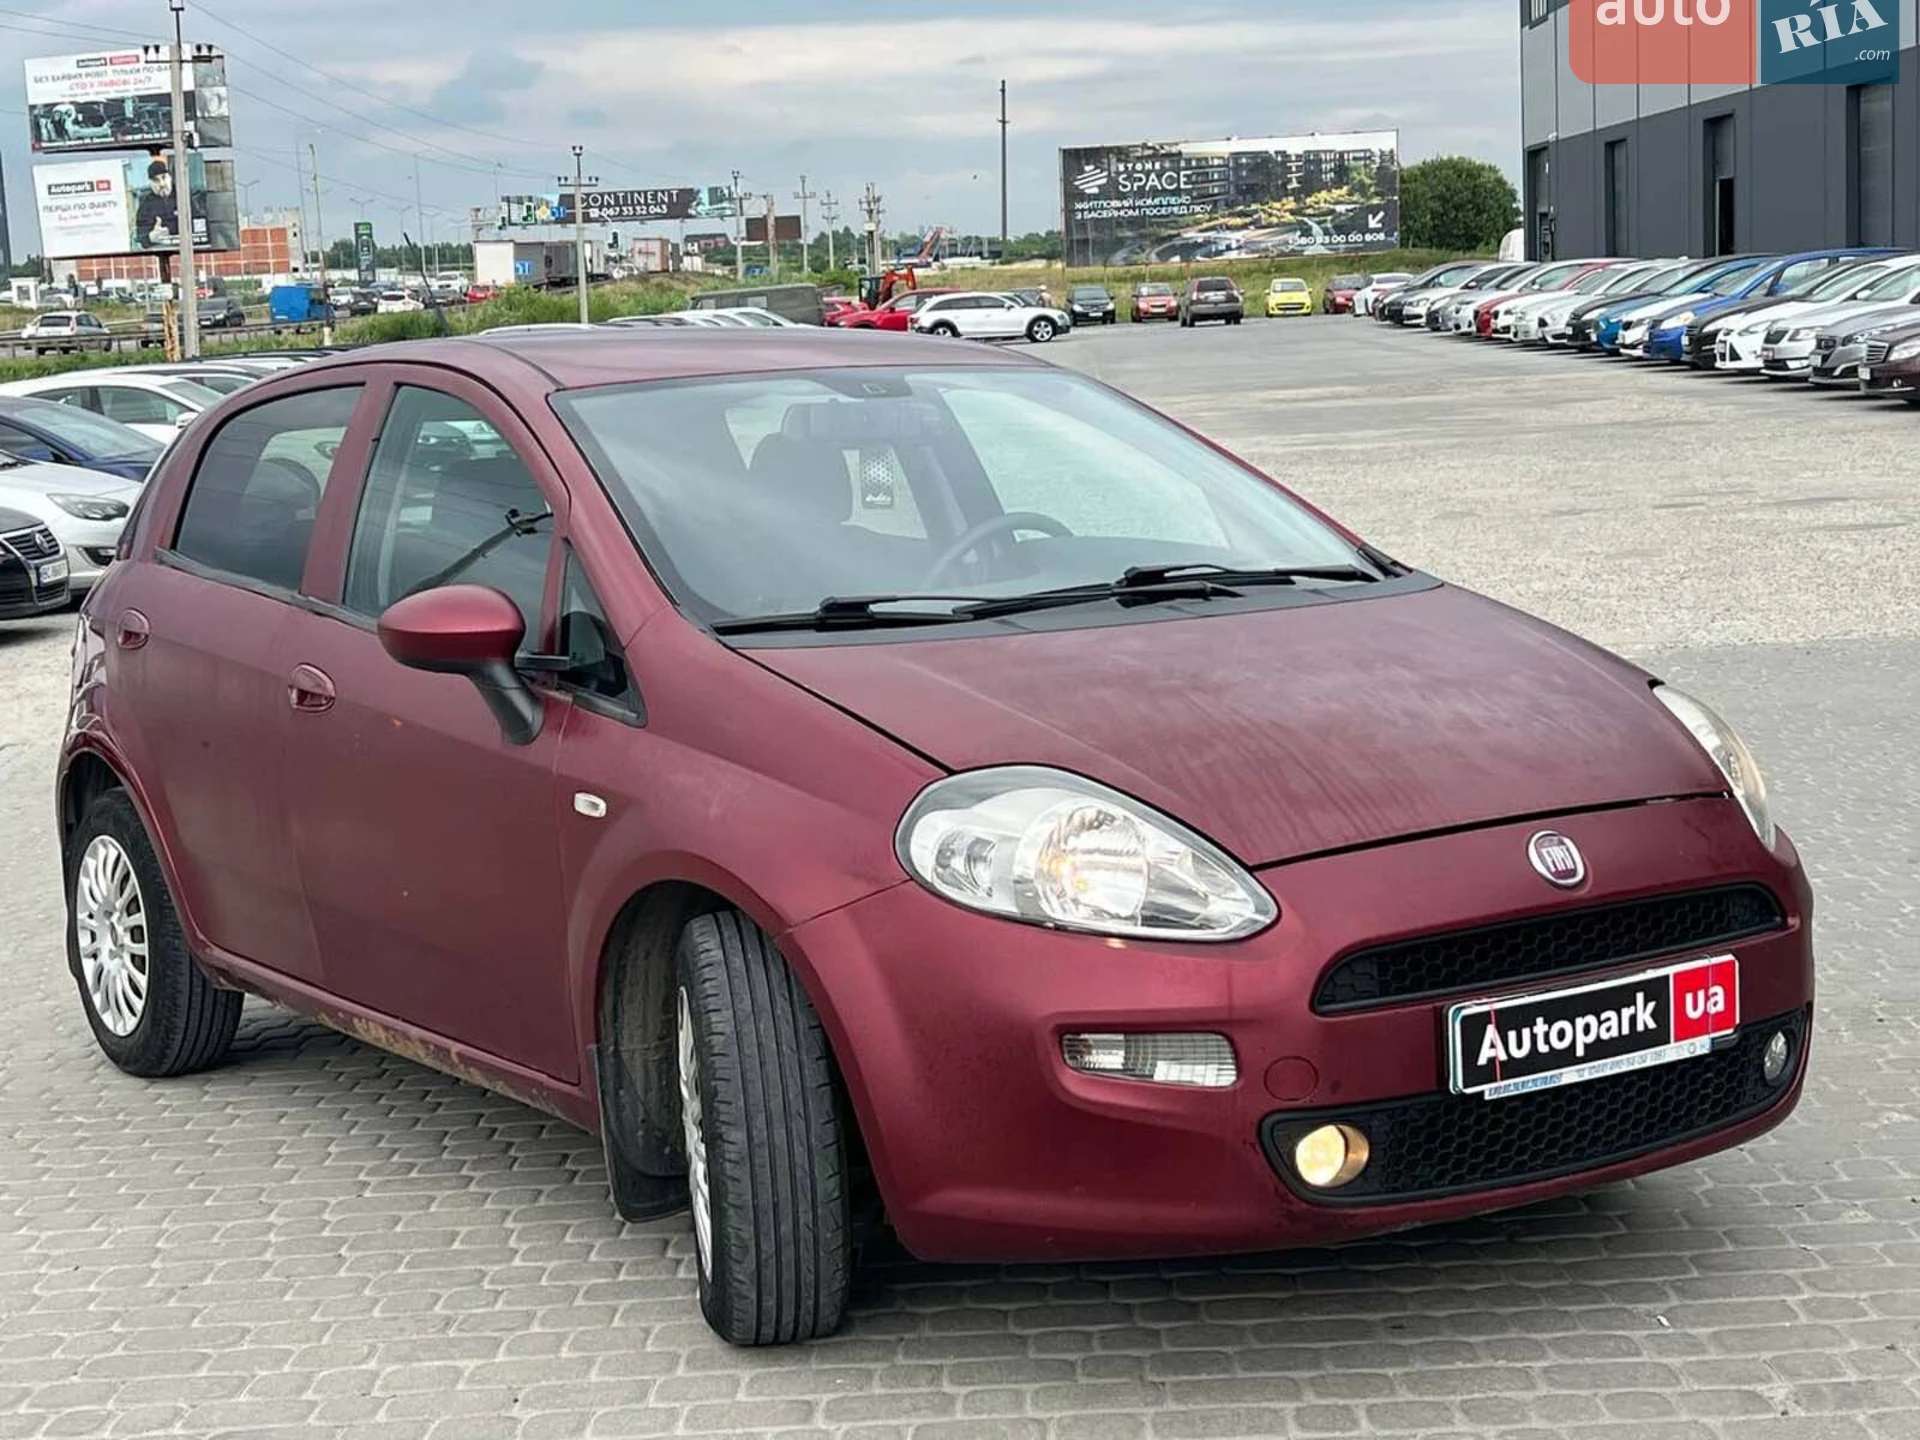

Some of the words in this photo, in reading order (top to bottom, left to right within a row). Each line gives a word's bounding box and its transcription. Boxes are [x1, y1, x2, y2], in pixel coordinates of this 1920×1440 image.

[50, 183, 92, 193] Autopark
[1118, 170, 1193, 192] SPACE
[74, 202, 86, 211] ПО
[580, 190, 679, 207] CONTINENT
[1074, 197, 1133, 210] ЖИТЛОВИЙ
[1135, 195, 1192, 206] КОМПЛЕКС
[1084, 207, 1140, 219] БАСЕЙНОМ
[1141, 205, 1189, 216] ПОСЕРЕД
[1189, 203, 1213, 214] ЛІСУ
[1541, 845, 1575, 873] FIAT
[1477, 992, 1657, 1066] Autopark
[1685, 984, 1725, 1019] ua
